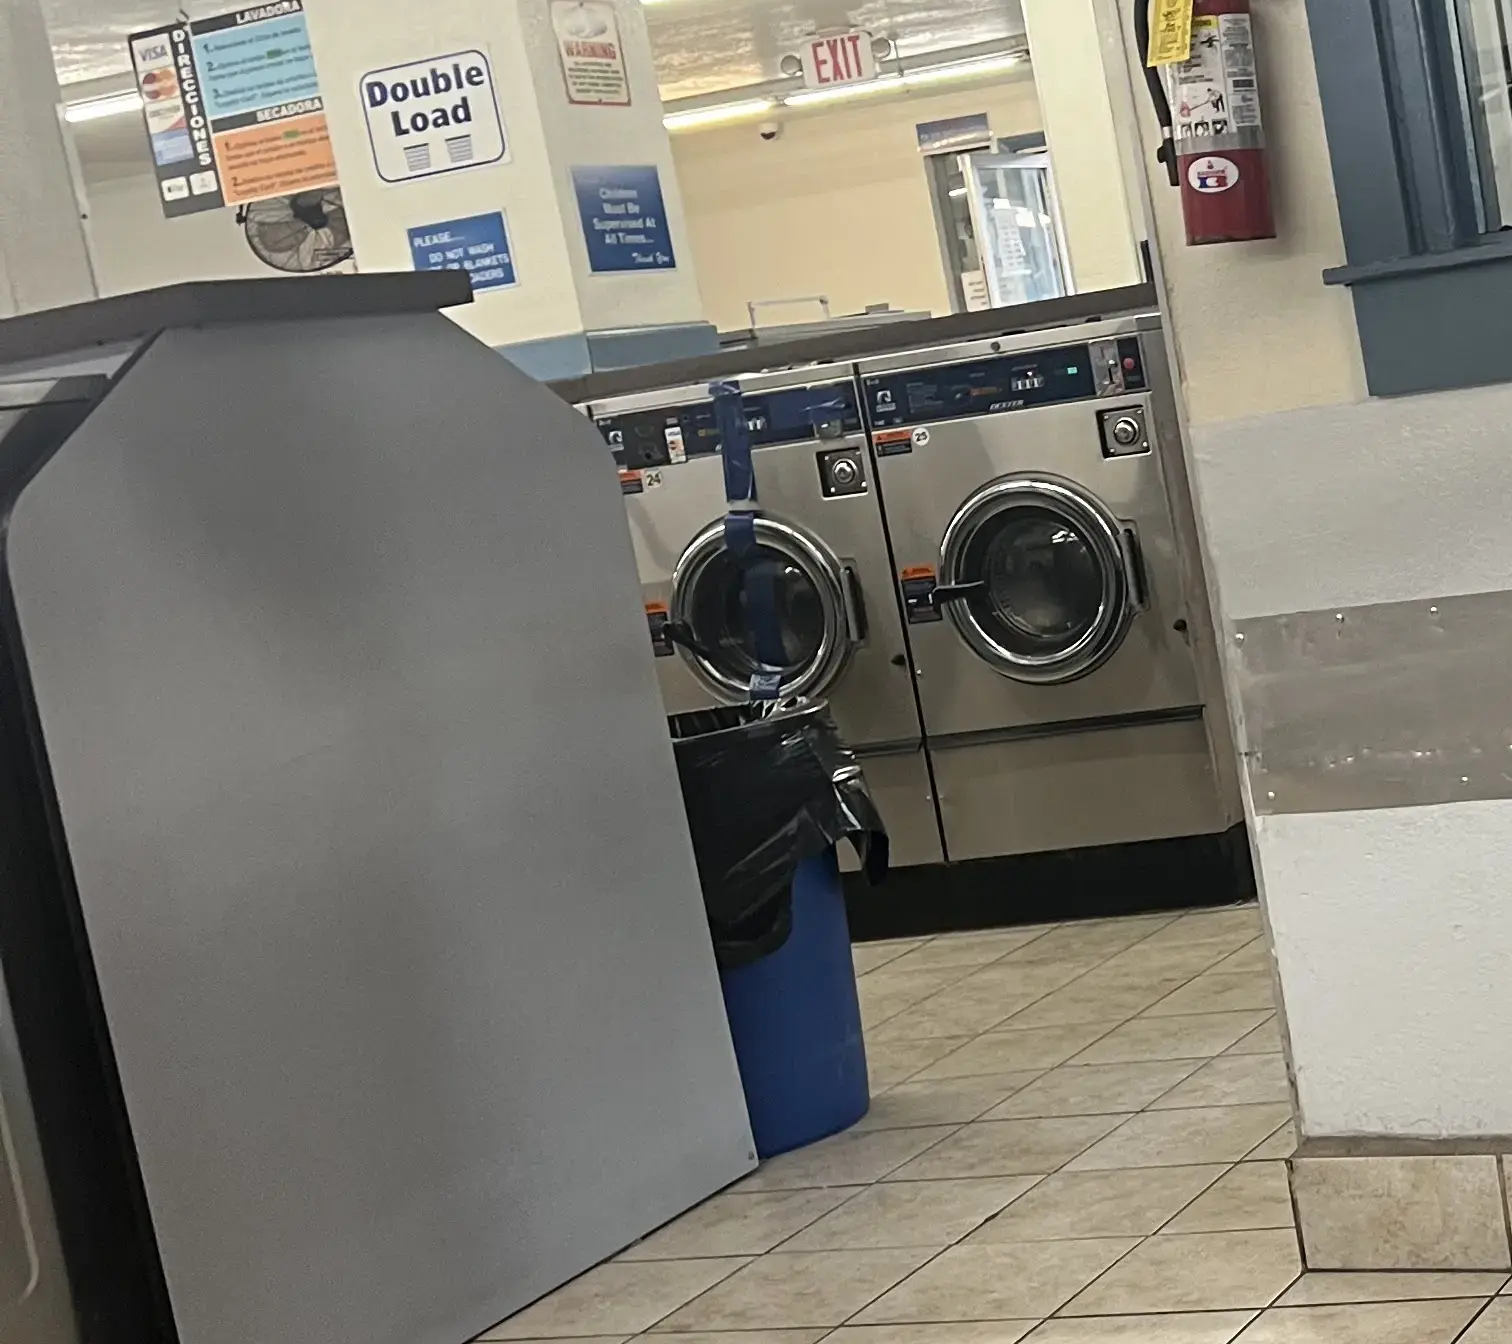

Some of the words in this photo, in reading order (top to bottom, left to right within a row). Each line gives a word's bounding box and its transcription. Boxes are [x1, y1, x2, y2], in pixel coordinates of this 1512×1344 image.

[236, 0, 300, 24] LAVADORA
[138, 44, 169, 62] VISA
[811, 35, 863, 84] EXIT
[172, 29, 212, 166] DIRECCIONES
[365, 63, 485, 108] Double
[390, 96, 472, 137] Load
[428, 252, 443, 263] DO
[445, 248, 464, 260] NOT
[914, 431, 928, 442] 25
[646, 470, 662, 486] 24
